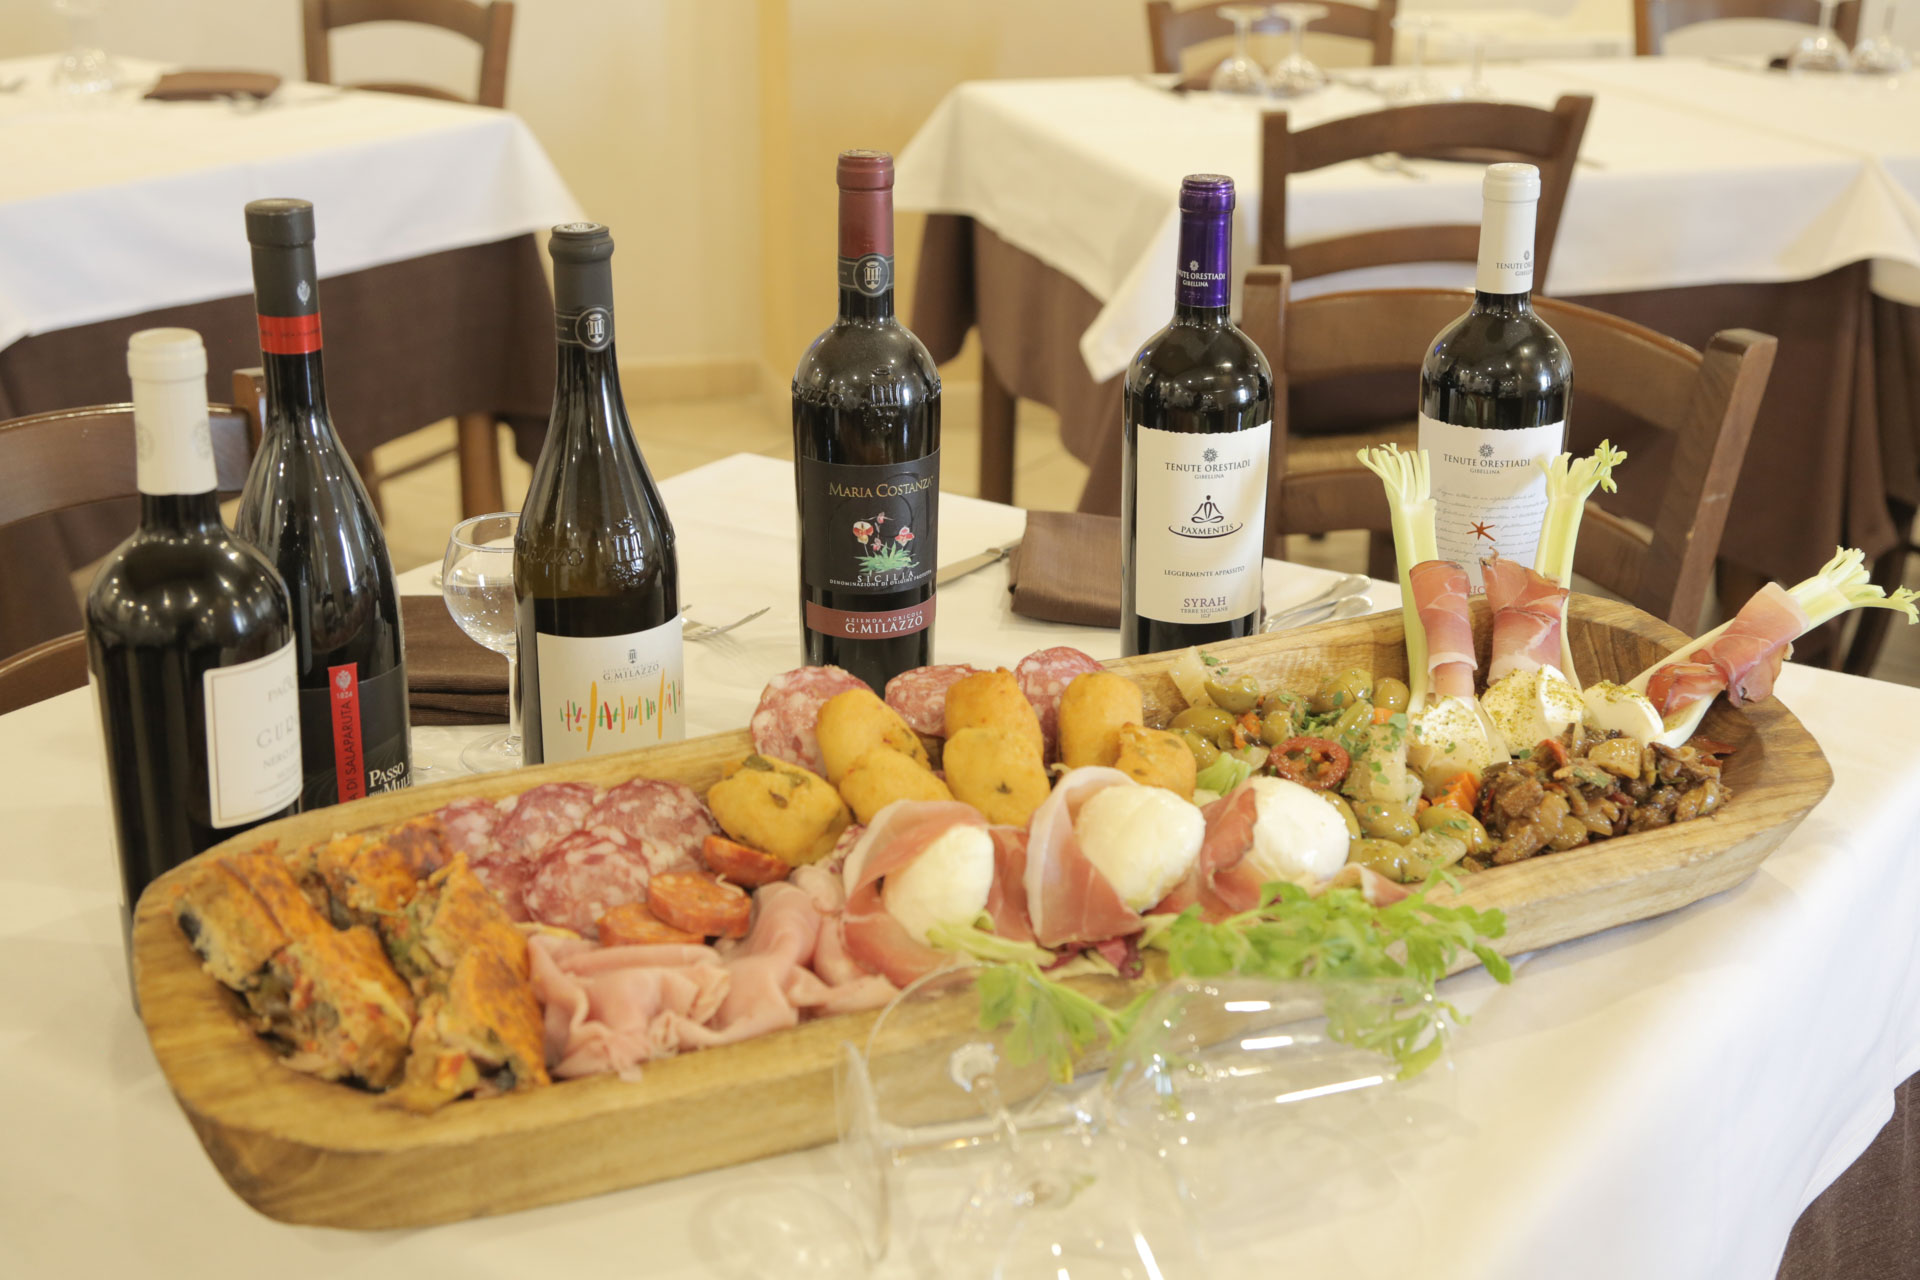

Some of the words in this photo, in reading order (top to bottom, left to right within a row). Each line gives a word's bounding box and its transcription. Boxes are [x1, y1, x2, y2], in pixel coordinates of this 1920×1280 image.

[1496, 262, 1523, 270] TENUTE
[1190, 272, 1226, 280] ORESTIADI
[1182, 279, 1209, 287] GIBELLINA
[1165, 462, 1202, 472] TENUTE
[1204, 459, 1251, 473] ORESTIADI
[1443, 453, 1478, 467] TENUTE
[1480, 458, 1531, 468] ORESTIADI
[829, 482, 874, 498] MARIA
[1181, 523, 1234, 535] PAXMENTIS
[857, 570, 914, 583] SICILIA
[1164, 569, 1213, 578] LEGGERMENTE
[1214, 565, 1246, 577] APPASSITO
[829, 578, 879, 588] DENOMINAZIONE
[889, 576, 913, 586] ORIGINE
[1184, 596, 1227, 608] SYRAH
[887, 610, 923, 622] AGRICOLA
[1200, 606, 1229, 614] SICILIANE
[845, 616, 923, 634] G.MILAZZO
[341, 701, 357, 774] SALAPARUTA
[346, 777, 359, 791] DI
